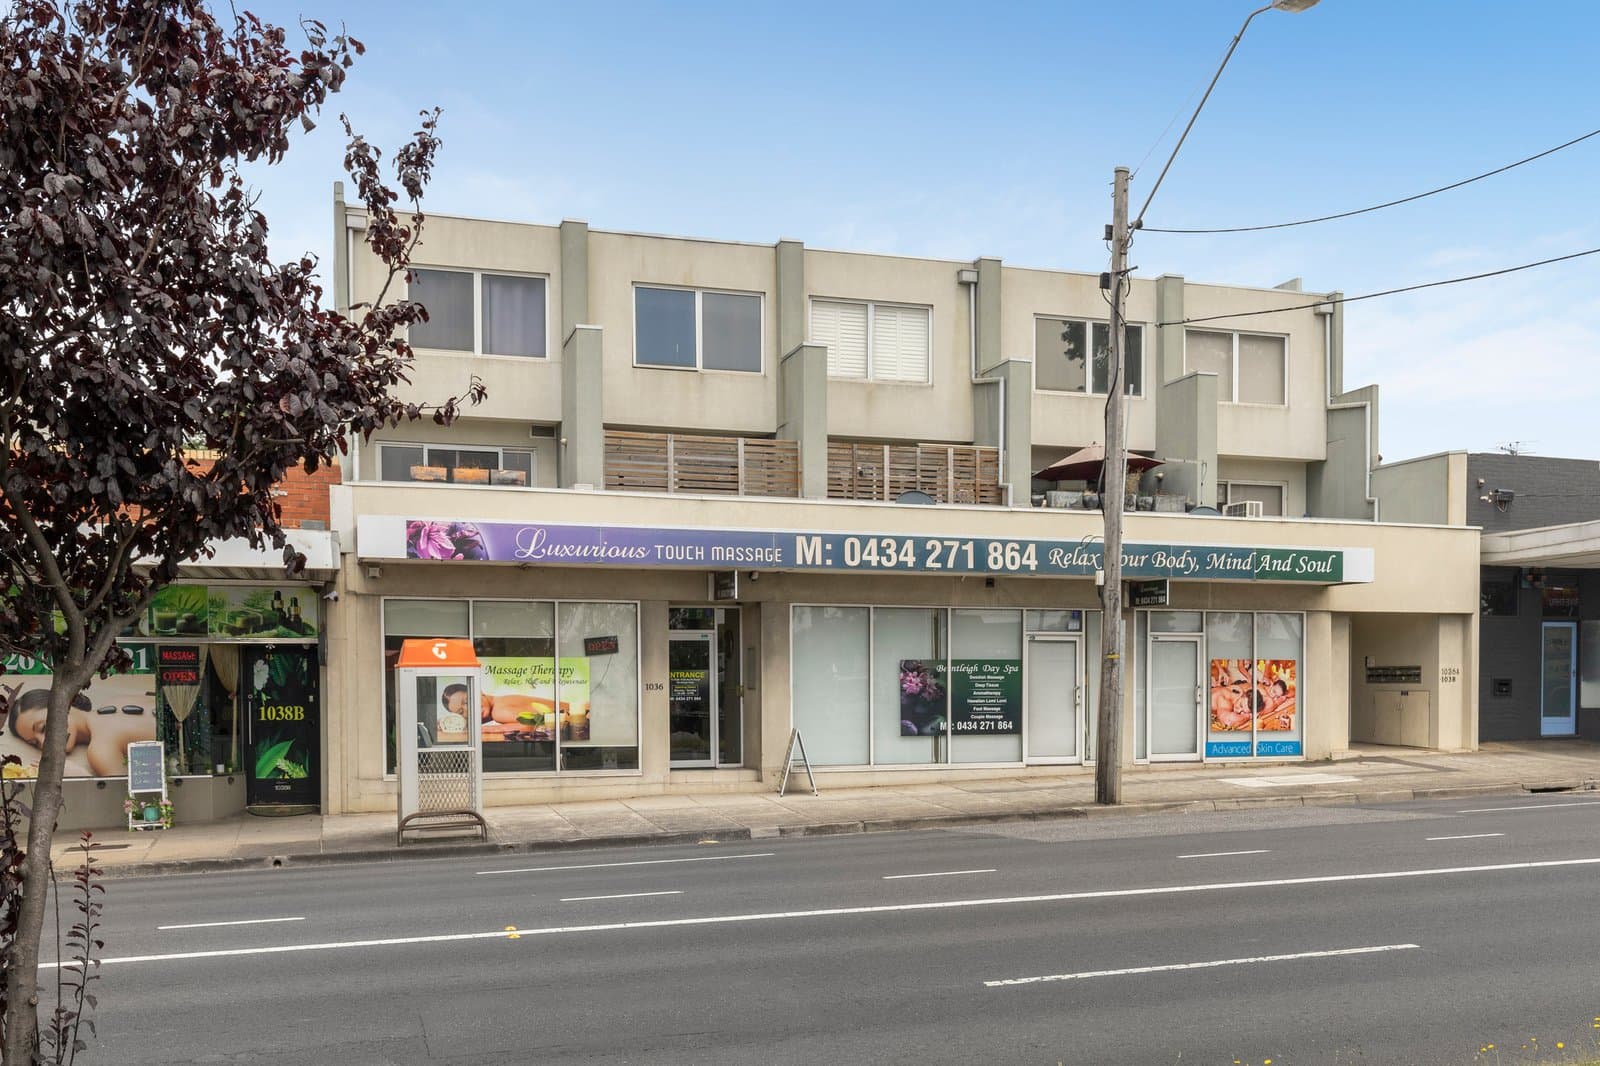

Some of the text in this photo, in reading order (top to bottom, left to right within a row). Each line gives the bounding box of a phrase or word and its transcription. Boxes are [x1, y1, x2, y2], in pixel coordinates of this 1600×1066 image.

[514, 526, 650, 560] Luxurious
[654, 544, 704, 561] TOUCH
[711, 546, 782, 563] MASSAGE
[795, 535, 832, 566] M:
[843, 537, 916, 568] 0434
[925, 540, 975, 569] 271
[987, 541, 1038, 571] 864
[1048, 547, 1103, 570] Relax
[1151, 550, 1200, 575] Body,
[1206, 551, 1256, 571] Mind
[1255, 553, 1296, 573] And
[1295, 553, 1337, 574] Soul
[485, 665, 528, 676] Massage
[982, 664, 1000, 674] Day
[1003, 663, 1019, 674] Spa
[162, 671, 197, 682] OPEN
[645, 682, 664, 691] 1036
[259, 705, 305, 721] 1038B
[956, 721, 978, 731] 0434
[979, 721, 995, 730] 271
[997, 720, 1013, 730] 864
[1212, 743, 1294, 754] Advanced Skin Care
